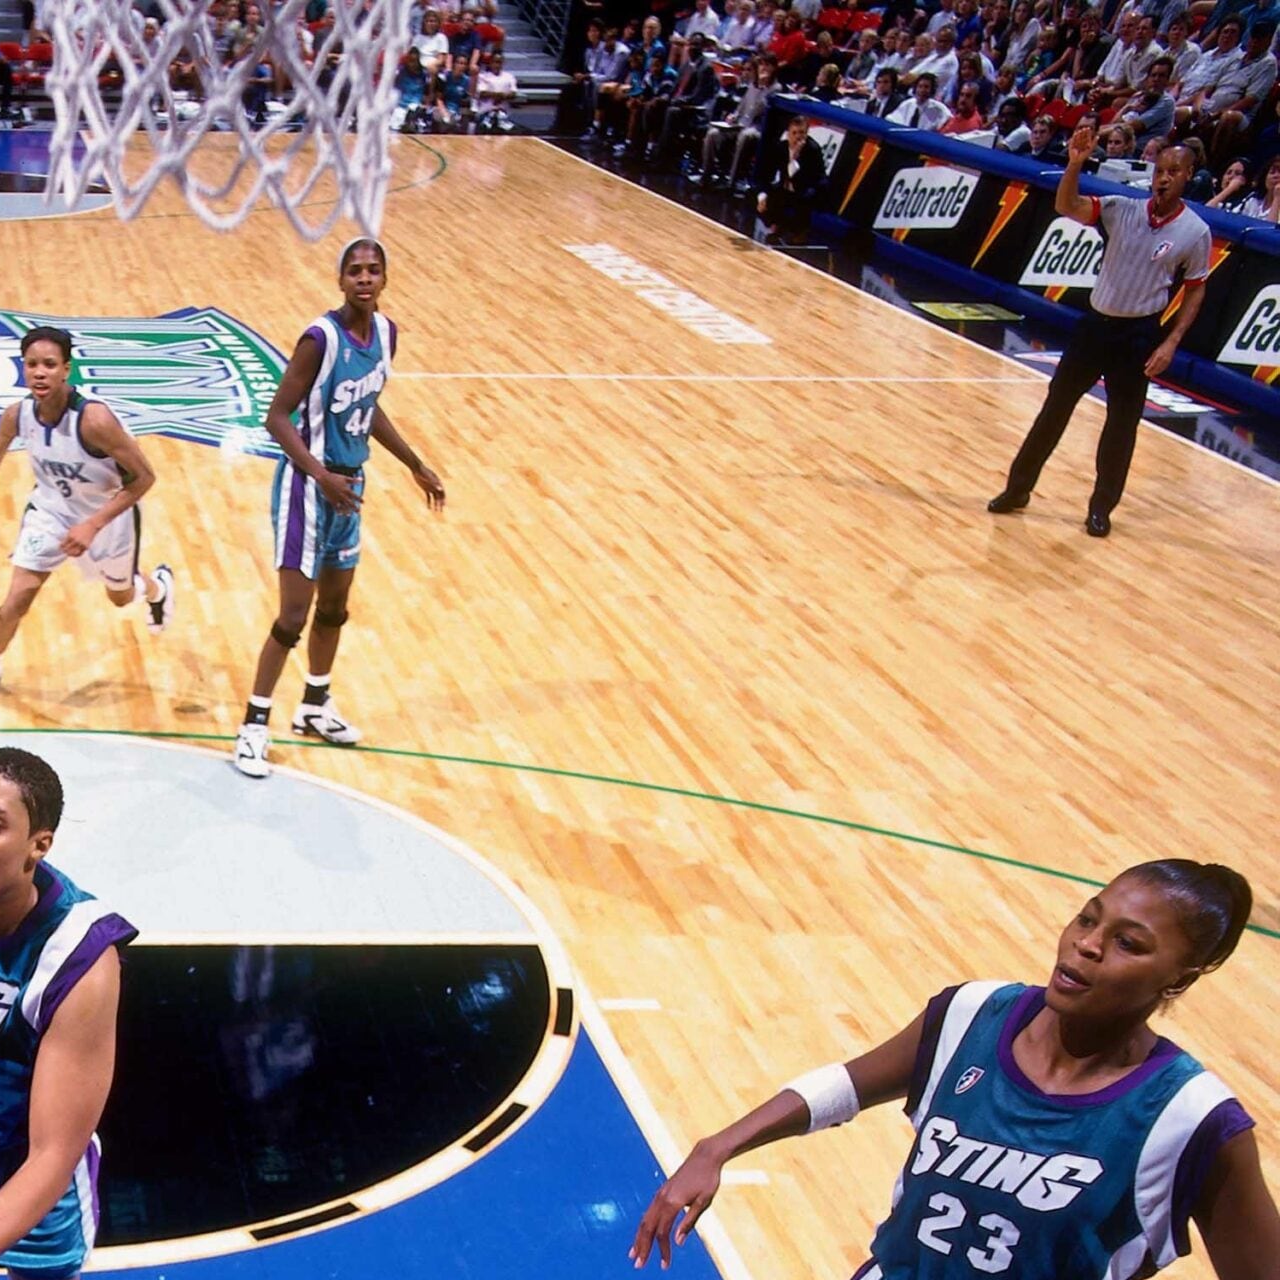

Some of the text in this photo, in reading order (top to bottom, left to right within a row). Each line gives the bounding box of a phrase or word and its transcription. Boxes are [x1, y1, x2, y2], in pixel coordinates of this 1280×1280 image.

[882, 175, 970, 219] Gatorade
[211, 333, 280, 423] MINNESO
[55, 479, 72, 498] 3
[910, 1115, 1105, 1213] STING
[917, 1191, 1021, 1274] 23
